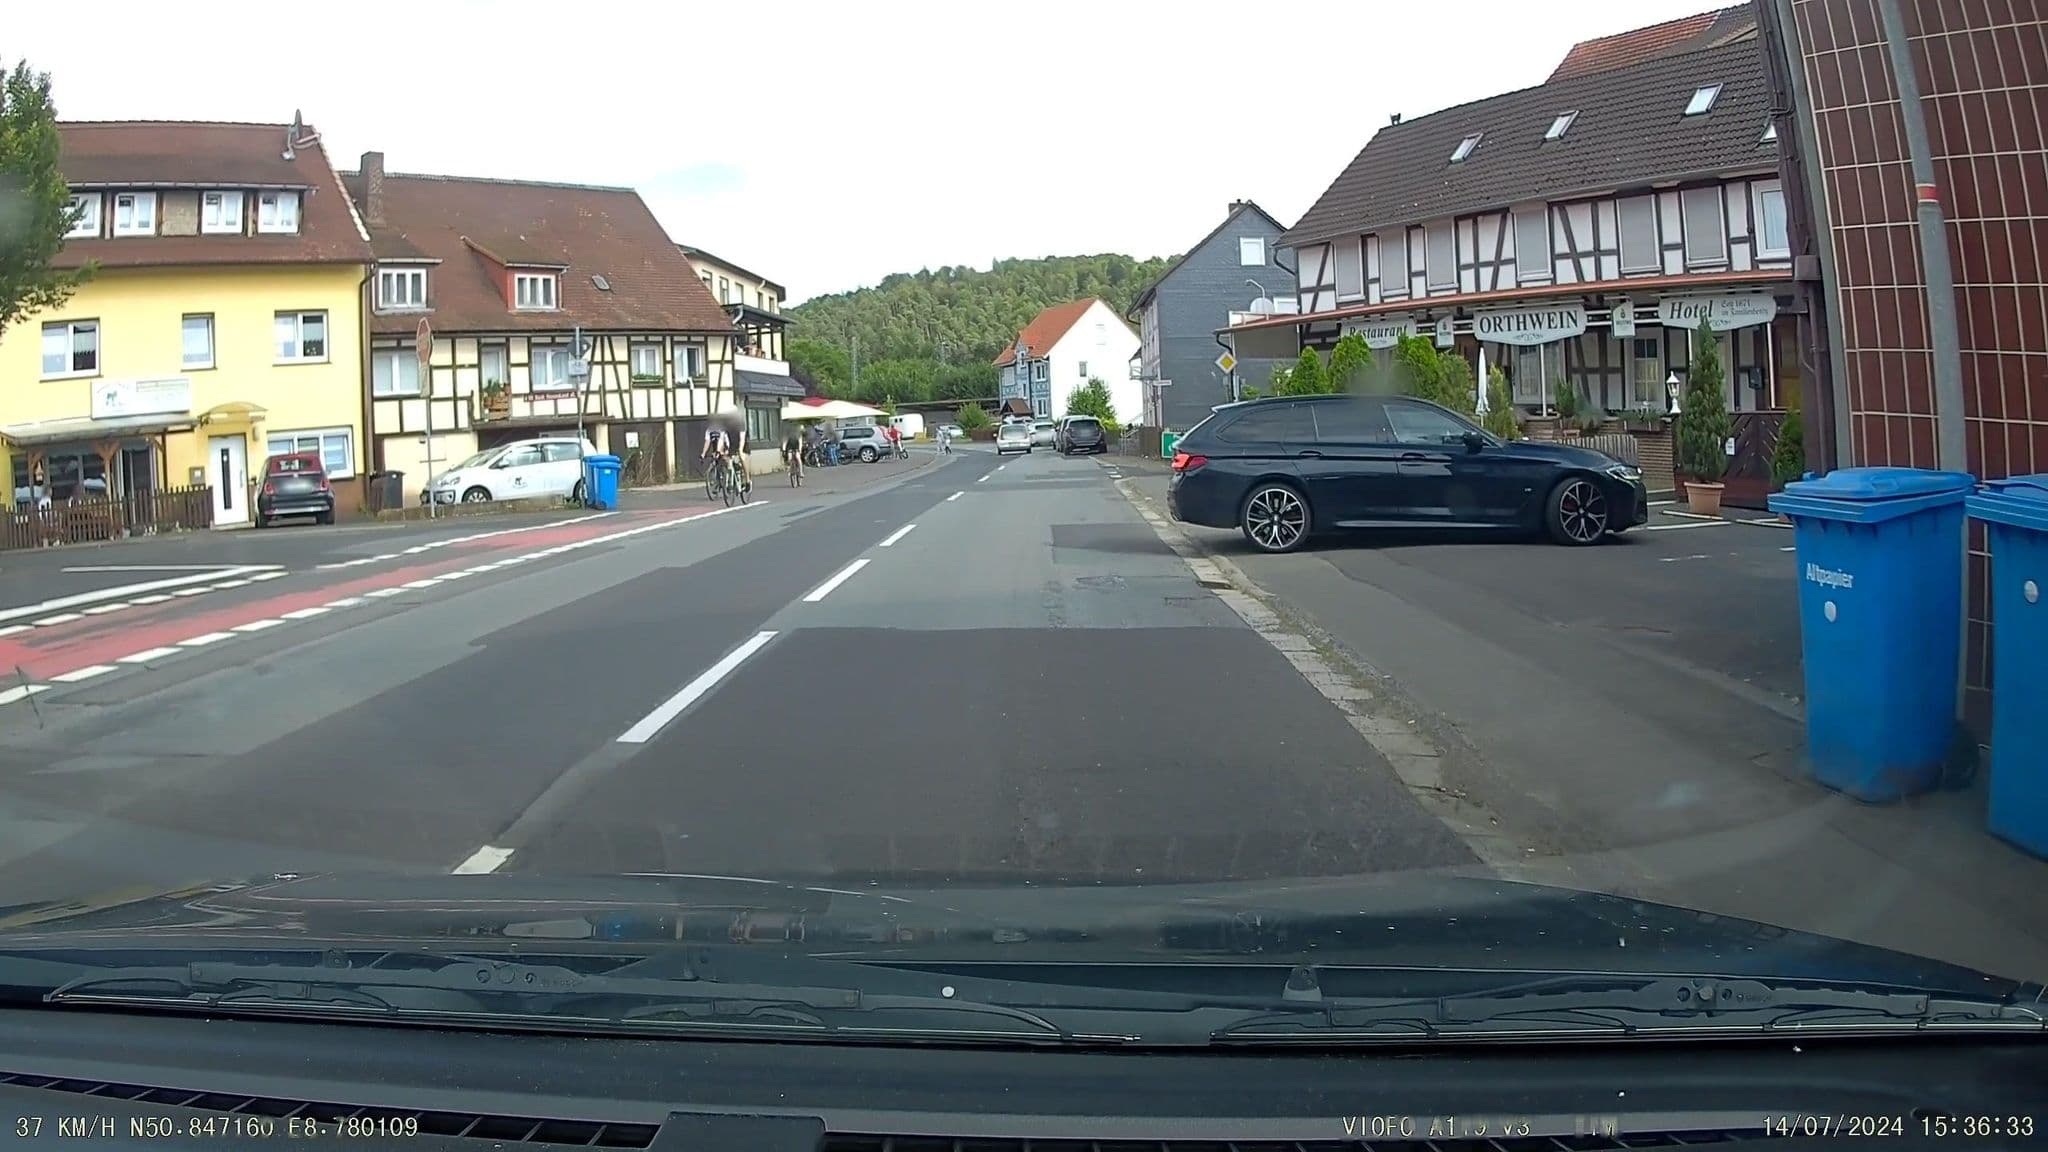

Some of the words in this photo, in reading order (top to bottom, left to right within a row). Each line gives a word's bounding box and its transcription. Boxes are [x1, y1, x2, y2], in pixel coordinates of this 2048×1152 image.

[1479, 310, 1579, 333] ORTHWEIN
[1669, 300, 1713, 320] Hotel
[1806, 562, 1854, 590] Altpapier
